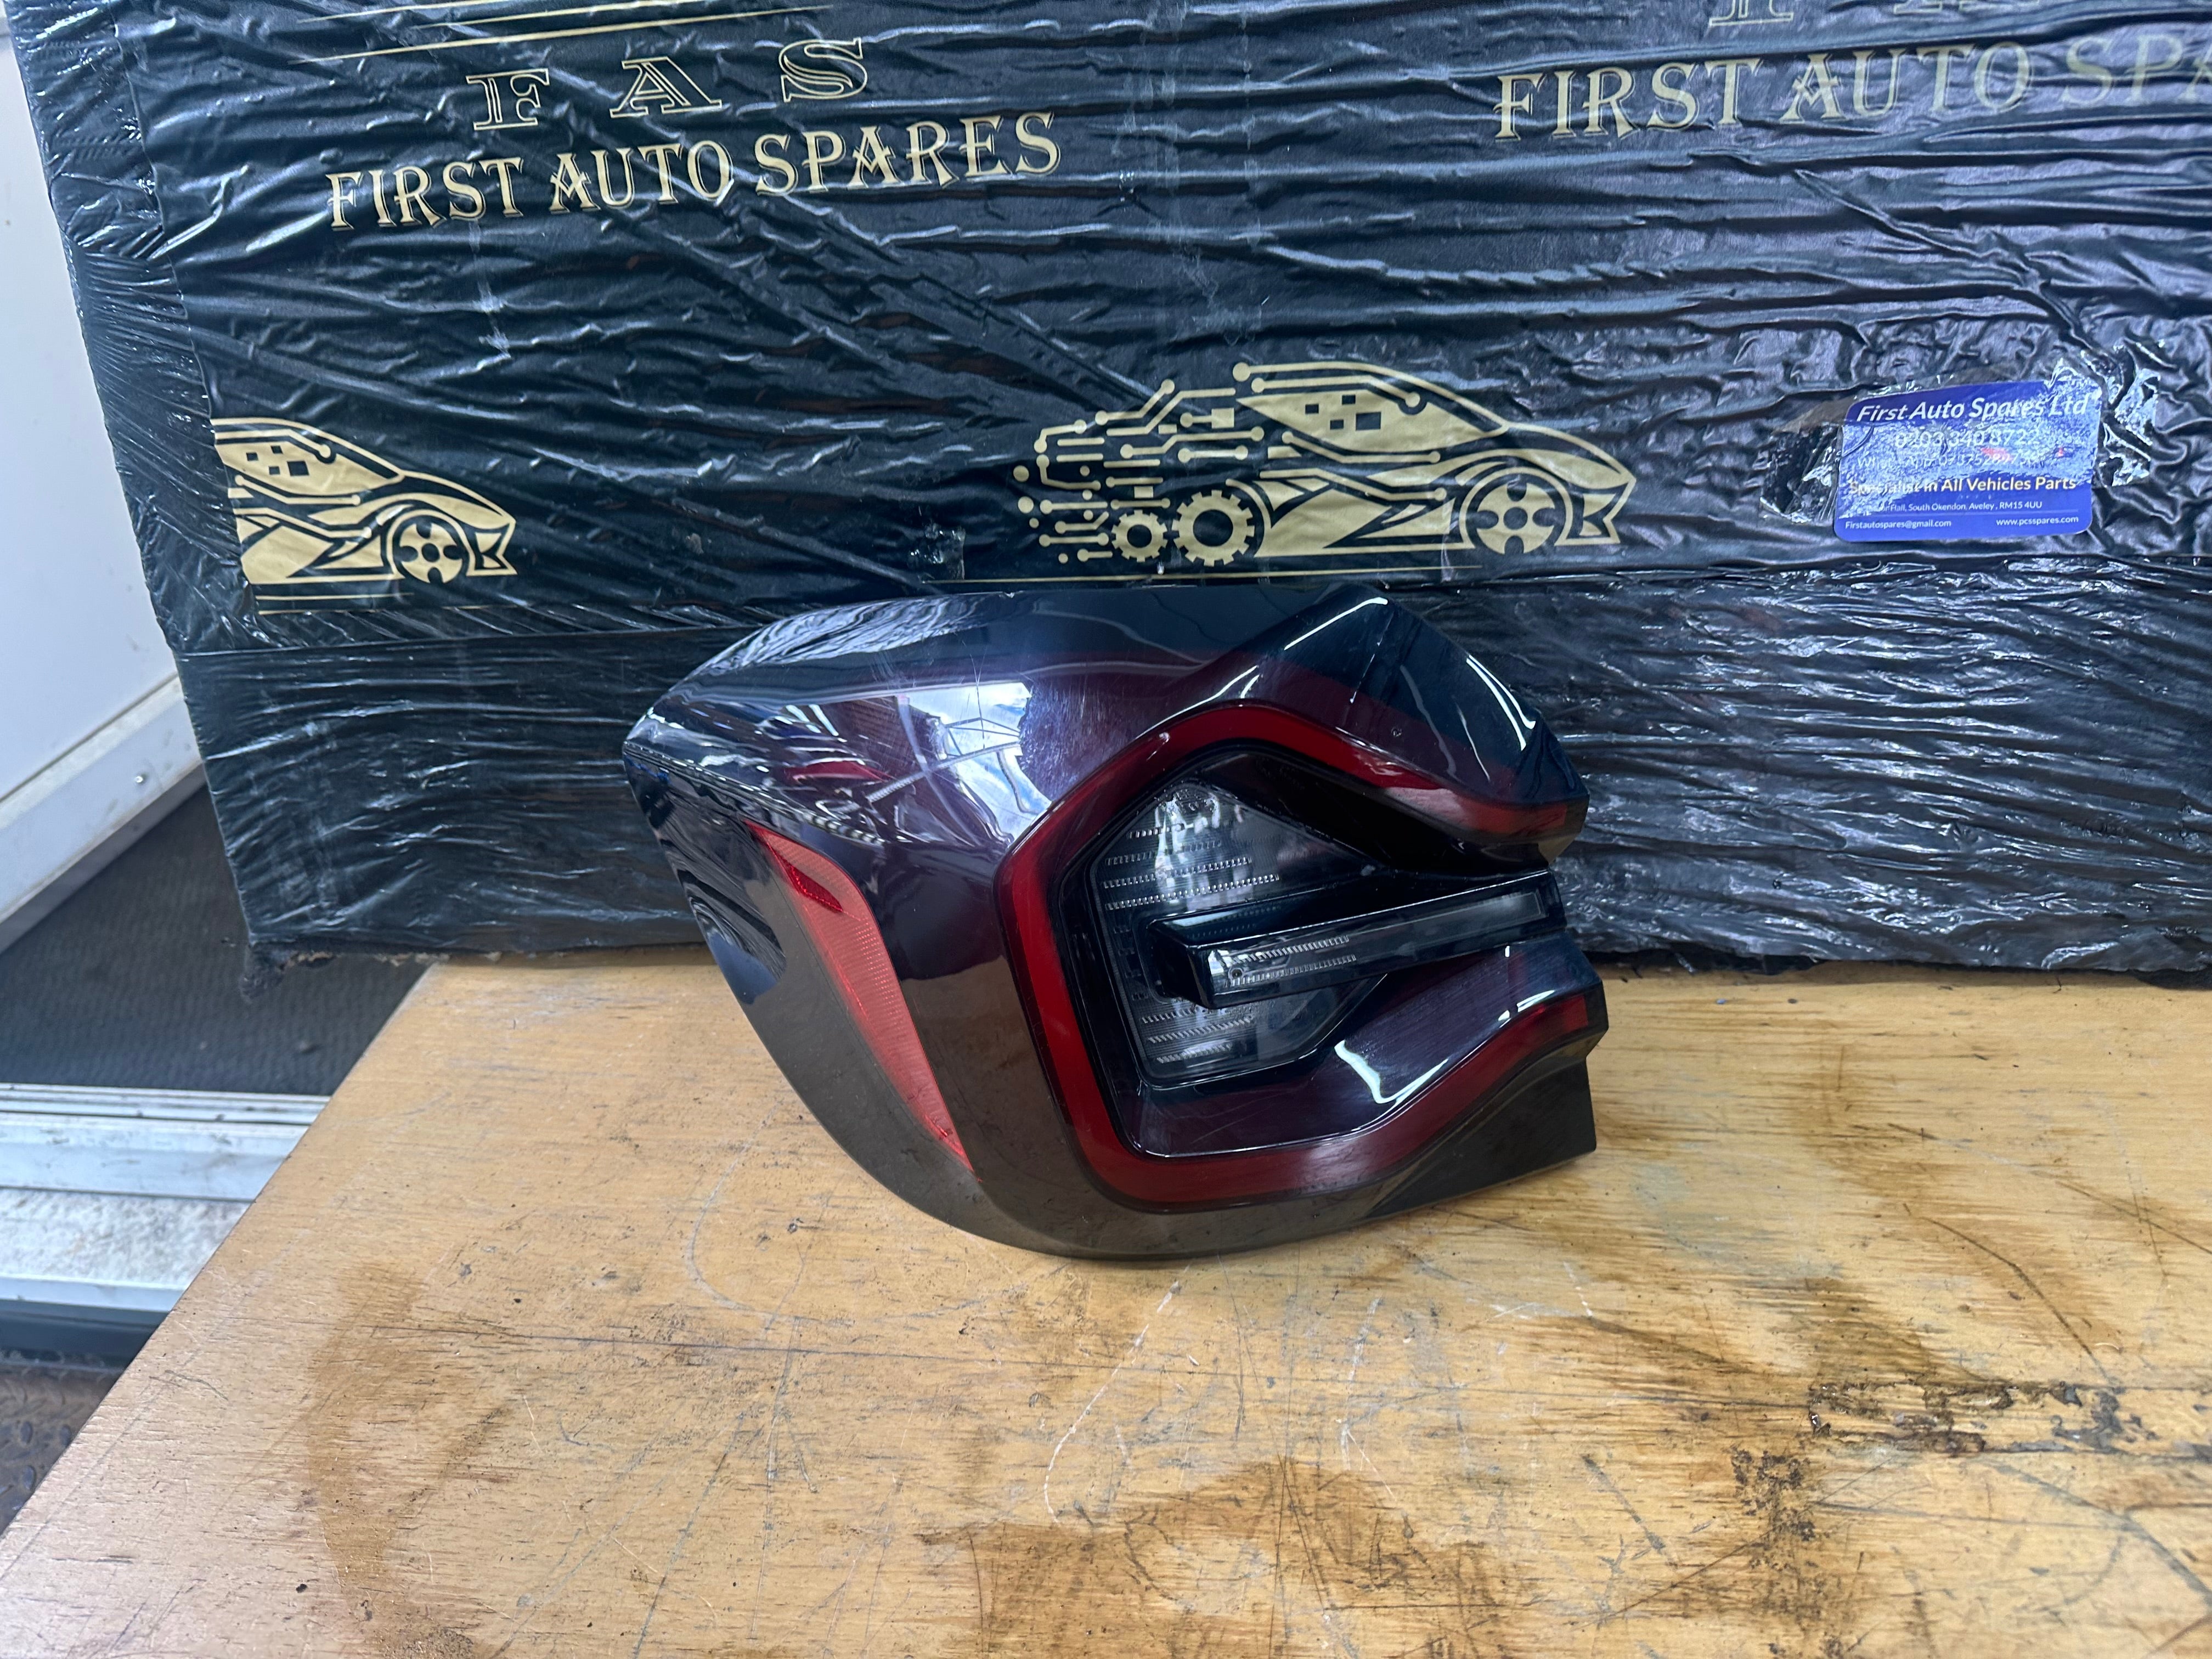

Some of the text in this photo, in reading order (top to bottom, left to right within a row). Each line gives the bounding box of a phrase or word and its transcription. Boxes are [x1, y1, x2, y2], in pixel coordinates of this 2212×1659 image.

[1493, 57, 1763, 142] FIRST
[1779, 41, 2034, 125] AUTO
[326, 112, 1061, 231] FIRST AUTO SPARES
[1857, 392, 2090, 422] First Auto Spares Ltd
[1941, 478, 1963, 492] All
[1967, 477, 2031, 492] Vehicles
[2035, 476, 2077, 490] Parts
[1909, 503, 1930, 511] South
[1845, 516, 2079, 530] Firstautospares@gmail.com www.pcsspares.com
